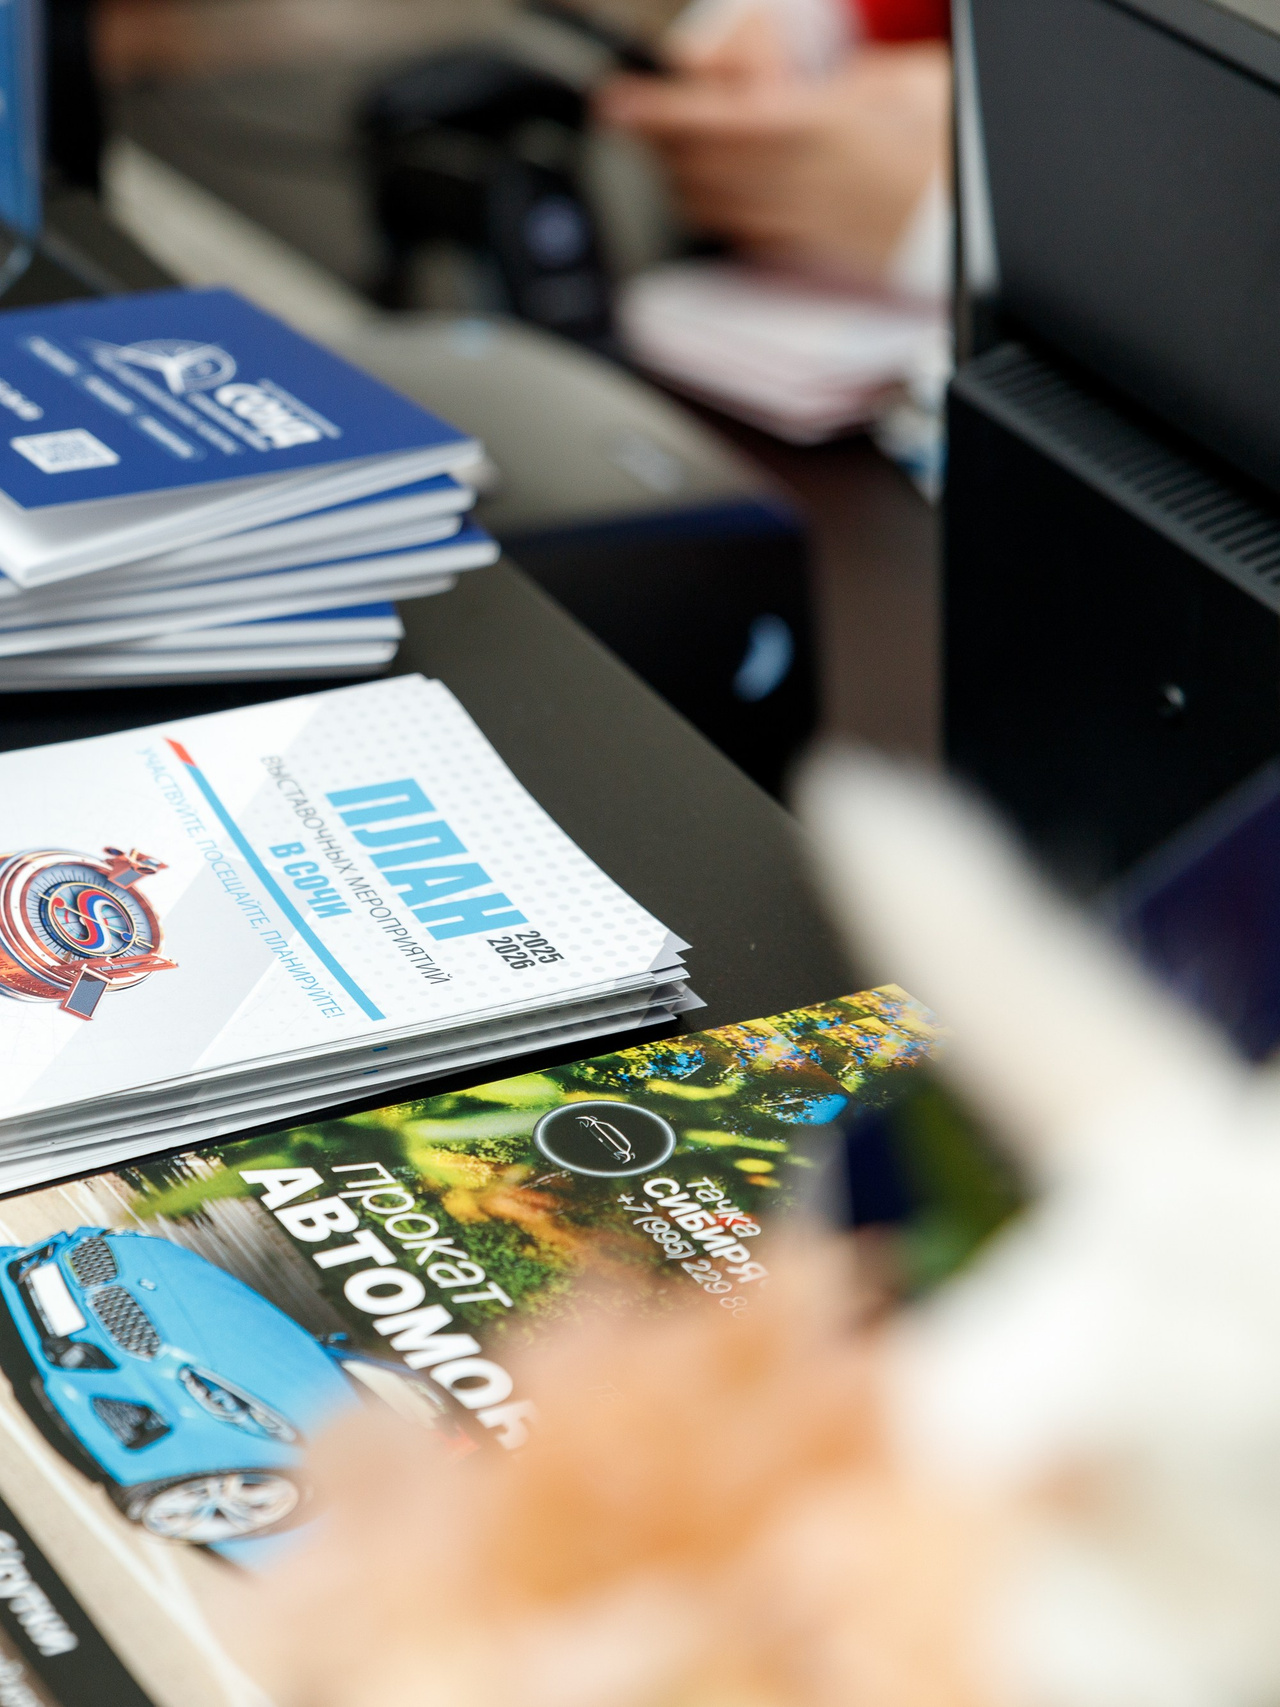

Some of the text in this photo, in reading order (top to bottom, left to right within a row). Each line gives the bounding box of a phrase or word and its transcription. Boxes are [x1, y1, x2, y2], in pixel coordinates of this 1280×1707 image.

[260, 755, 450, 985] ВЫСТАВОЧНЫХ МЕРОПРИЯТИЙ
[268, 841, 353, 919] В СОЧИ
[325, 778, 530, 941] ПЛАН
[195, 840, 269, 930] ПОСЕЩАЙТЕ,
[259, 930, 346, 1021] ПЛАНИРУЙТЕ!
[486, 936, 537, 969] 2026
[515, 930, 564, 964] 2025
[331, 1161, 514, 1308] Прокат
[617, 1193, 653, 1214] +7
[633, 1216, 696, 1259] (995)
[643, 1177, 769, 1283] СИБИРЯ
[686, 1177, 761, 1237] тачка
[681, 1259, 732, 1293] 229
